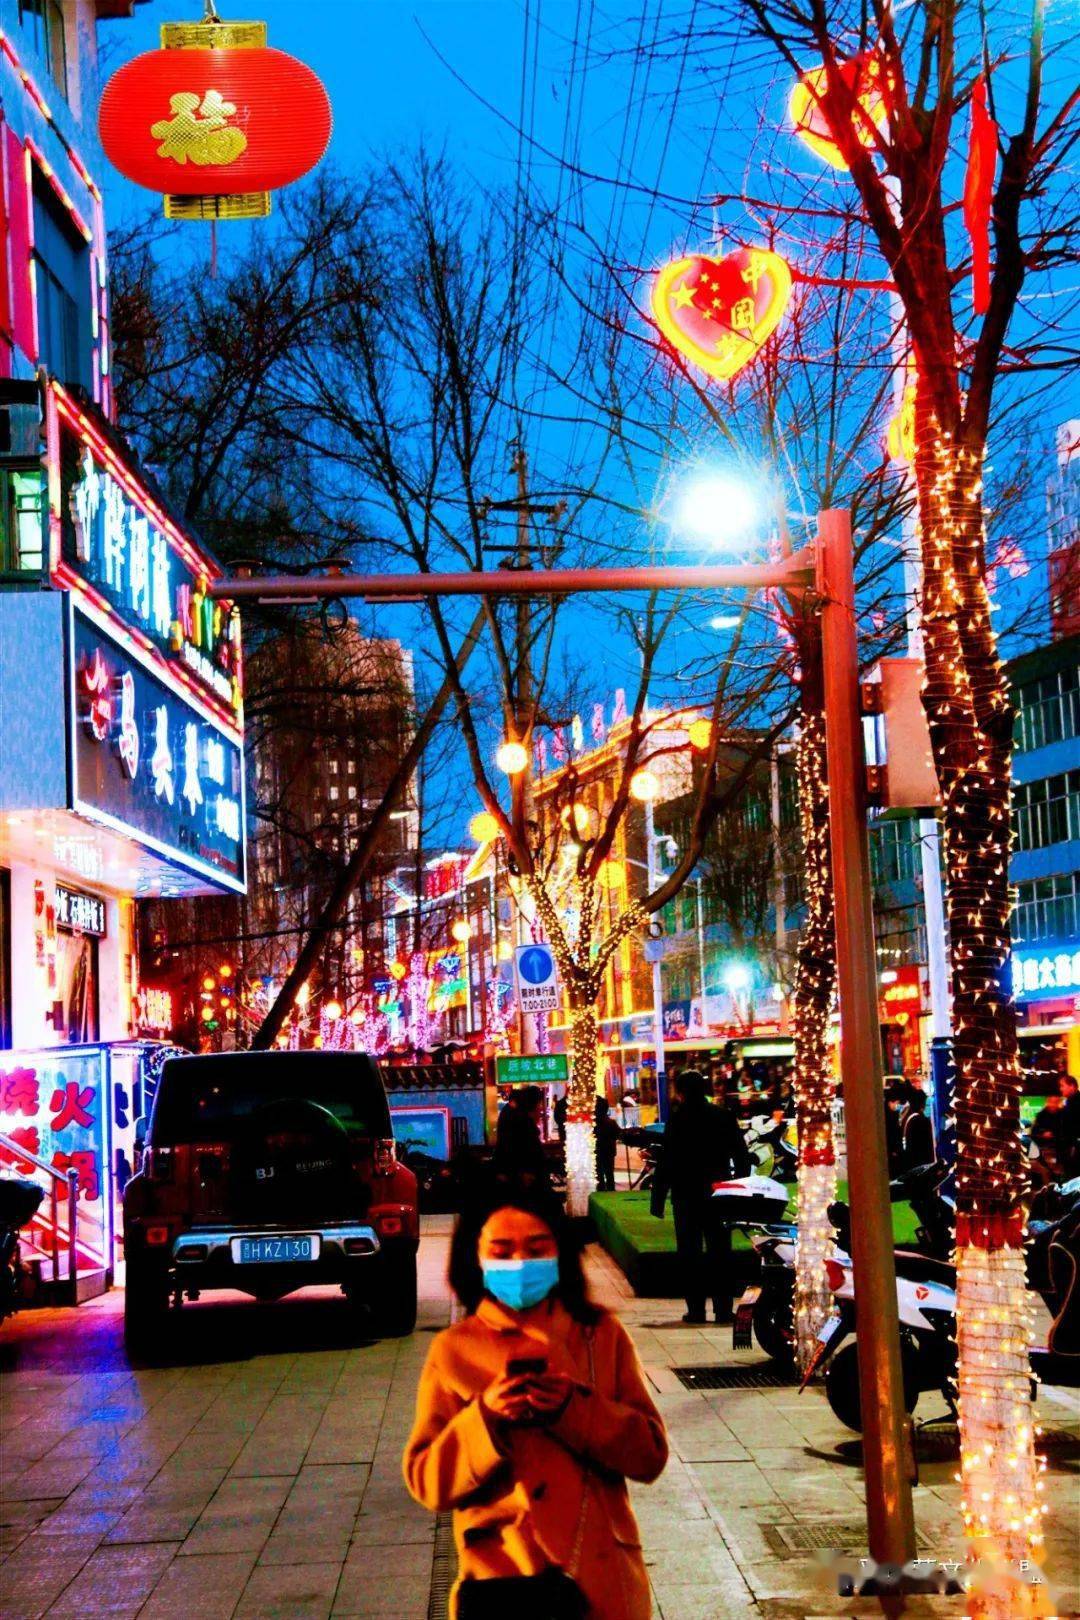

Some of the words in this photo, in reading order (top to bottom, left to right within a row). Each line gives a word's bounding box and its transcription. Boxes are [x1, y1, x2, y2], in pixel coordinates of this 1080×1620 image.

[151, 89, 248, 165] 福
[49, 1081, 99, 1201] 火锅
[256, 1166, 274, 1179] BJ
